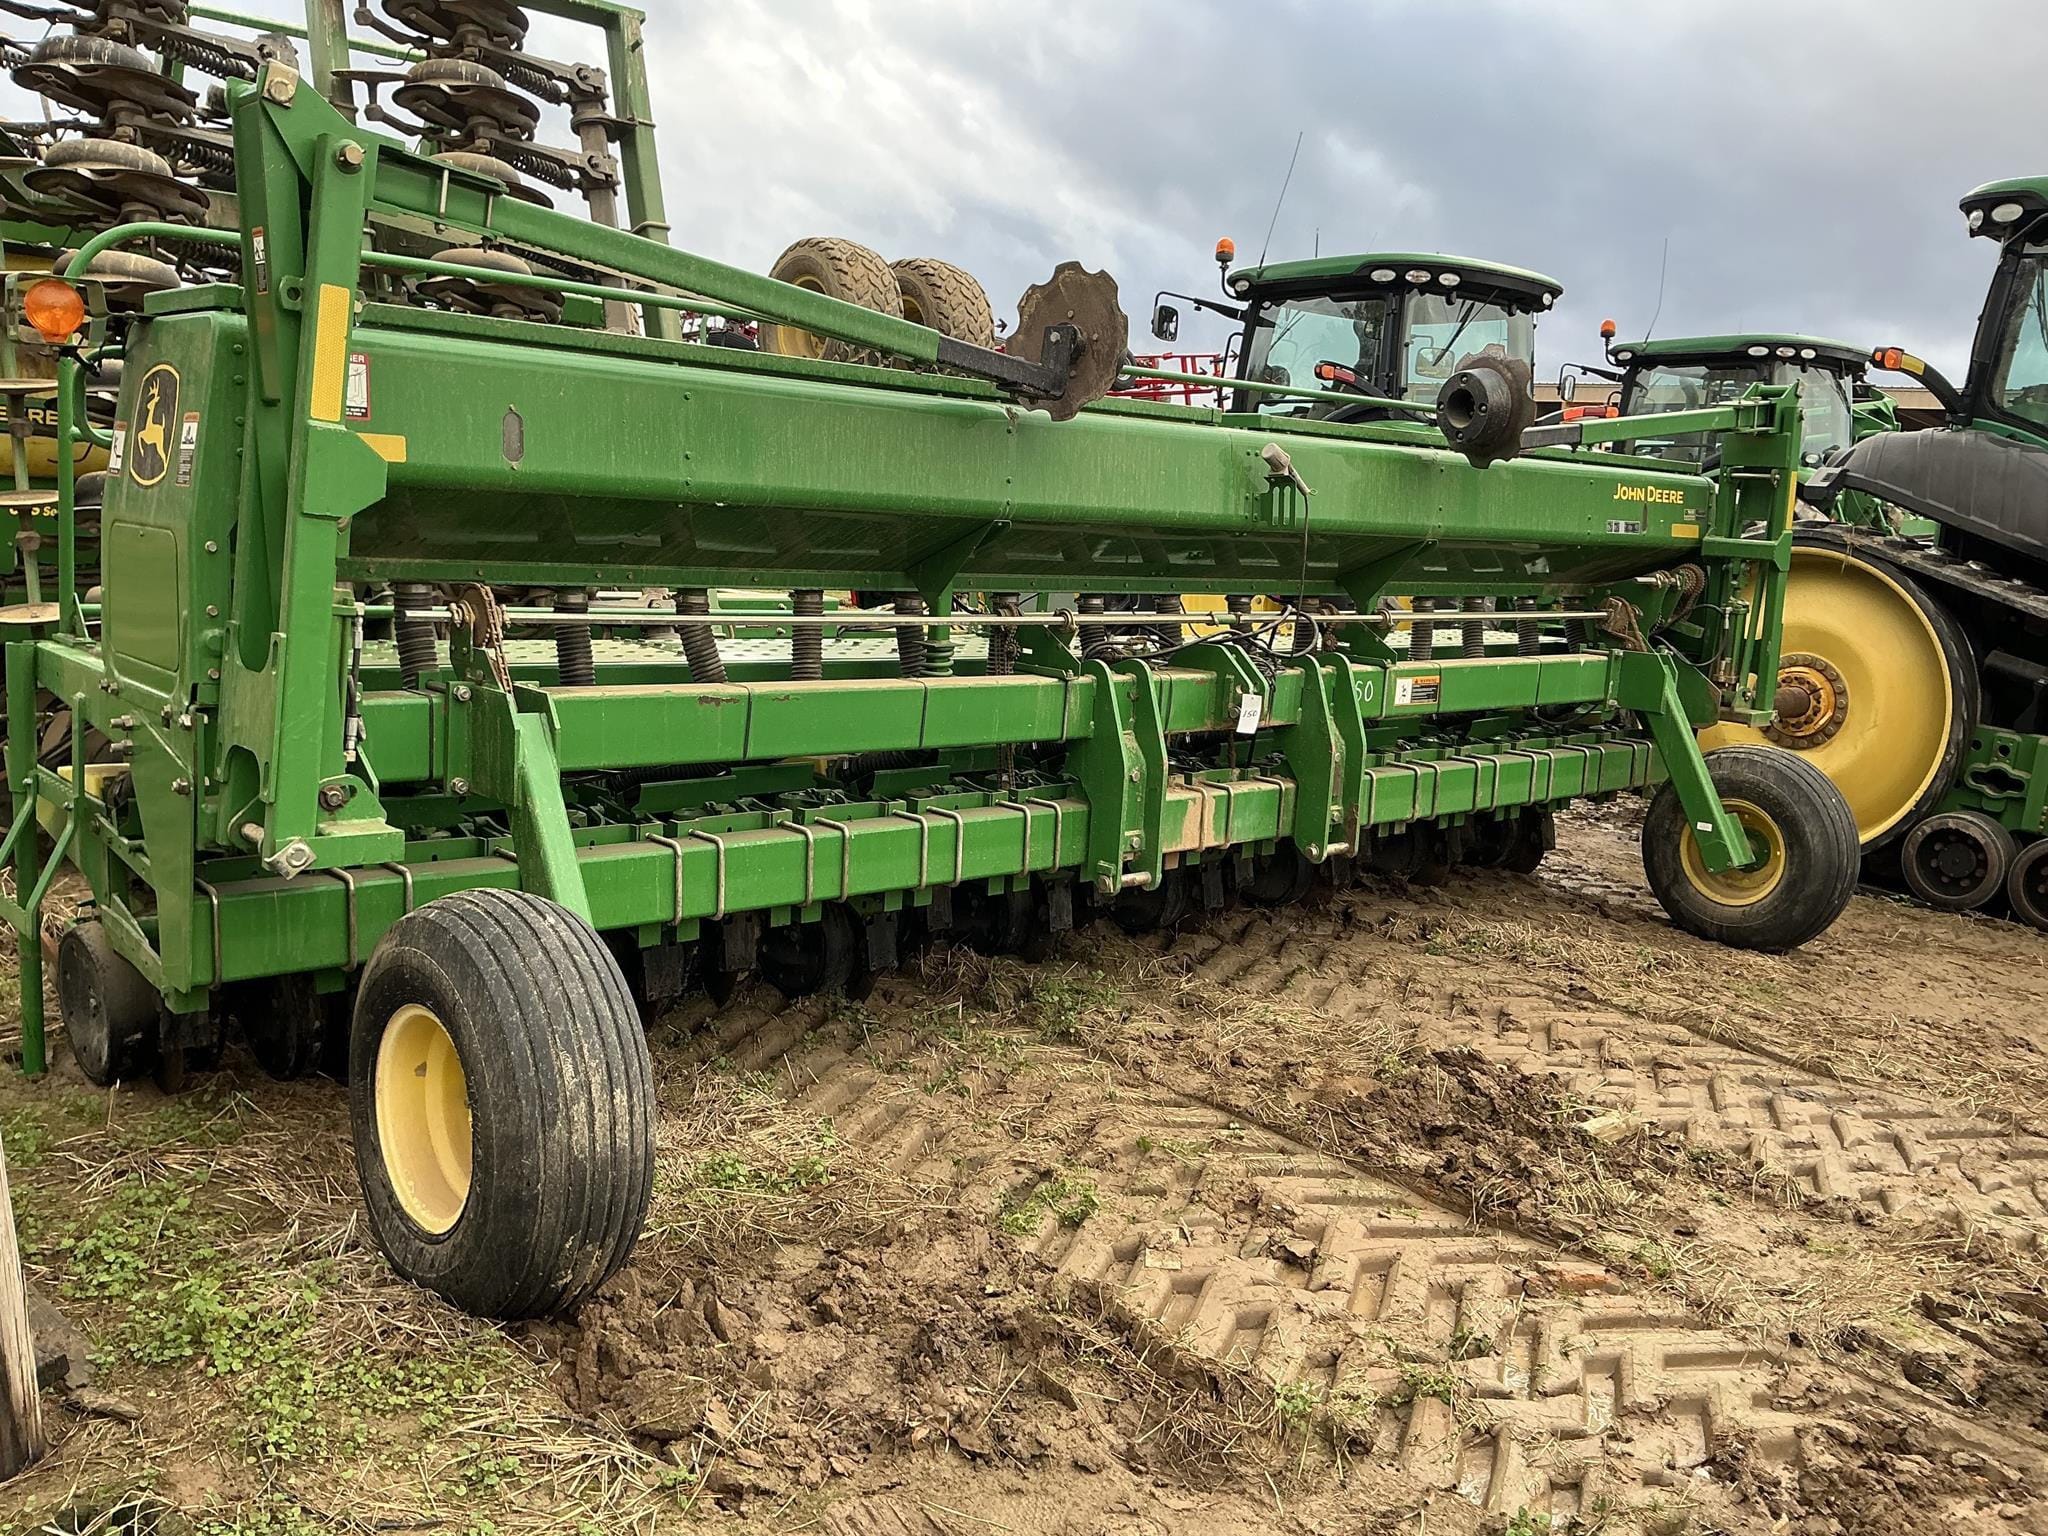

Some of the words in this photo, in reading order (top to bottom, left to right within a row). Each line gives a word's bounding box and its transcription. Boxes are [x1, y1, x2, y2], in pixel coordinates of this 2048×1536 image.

[0, 405, 58, 425] ERE
[1613, 483, 1645, 501] JOHN
[1647, 485, 1684, 504] DEERE
